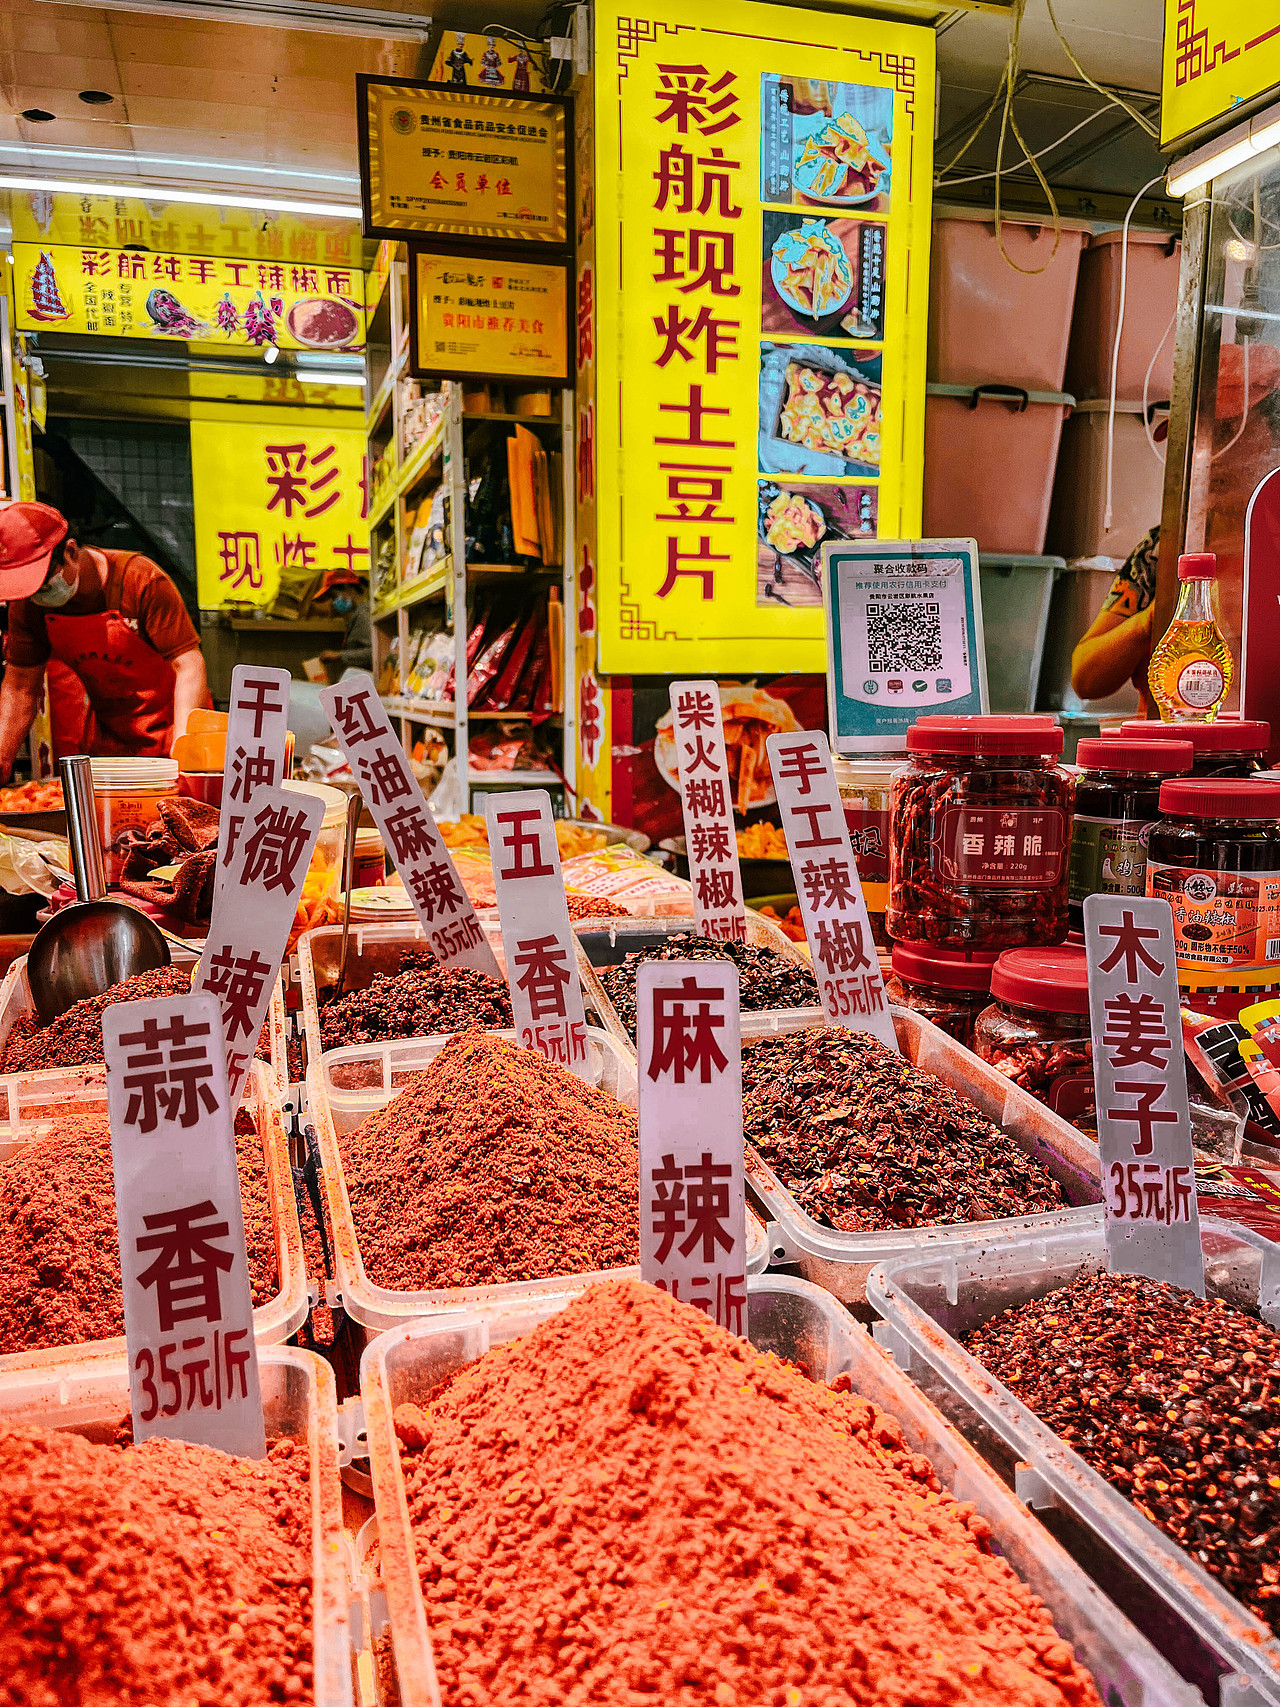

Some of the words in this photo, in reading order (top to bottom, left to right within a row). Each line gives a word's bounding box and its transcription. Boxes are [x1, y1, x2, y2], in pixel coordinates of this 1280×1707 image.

[429, 170, 513, 196] 会员单位
[81, 250, 351, 296] 彩航纯手工辣椒面
[442, 312, 544, 335] 贵阳市推荐美食
[653, 63, 742, 601] 彩航现炸土豆片
[265, 443, 368, 519] 彩
[855, 580, 948, 590] 推荐使用农行信用卡支付
[874, 563, 928, 574] 聚合收款码
[334, 690, 464, 922] 红油麻辣
[677, 690, 738, 911] 柴火糊辣椒
[778, 742, 872, 975] 手工辣椒
[962, 833, 1042, 856] 香辣脆
[1116, 859, 1147, 877] 鸡丁
[202, 803, 311, 1042] 微辣
[432, 913, 484, 962] 35元/斤
[497, 809, 571, 1021] 五香
[1174, 906, 1237, 926] 香油辣椒
[824, 974, 885, 1018] 35元/斤
[1097, 909, 1178, 1156] 木姜子
[647, 976, 736, 1265] 麻辣
[119, 1015, 235, 1333] 蒜香
[1111, 1161, 1192, 1226] 35元/斤
[134, 1327, 252, 1422] 35元/斤
